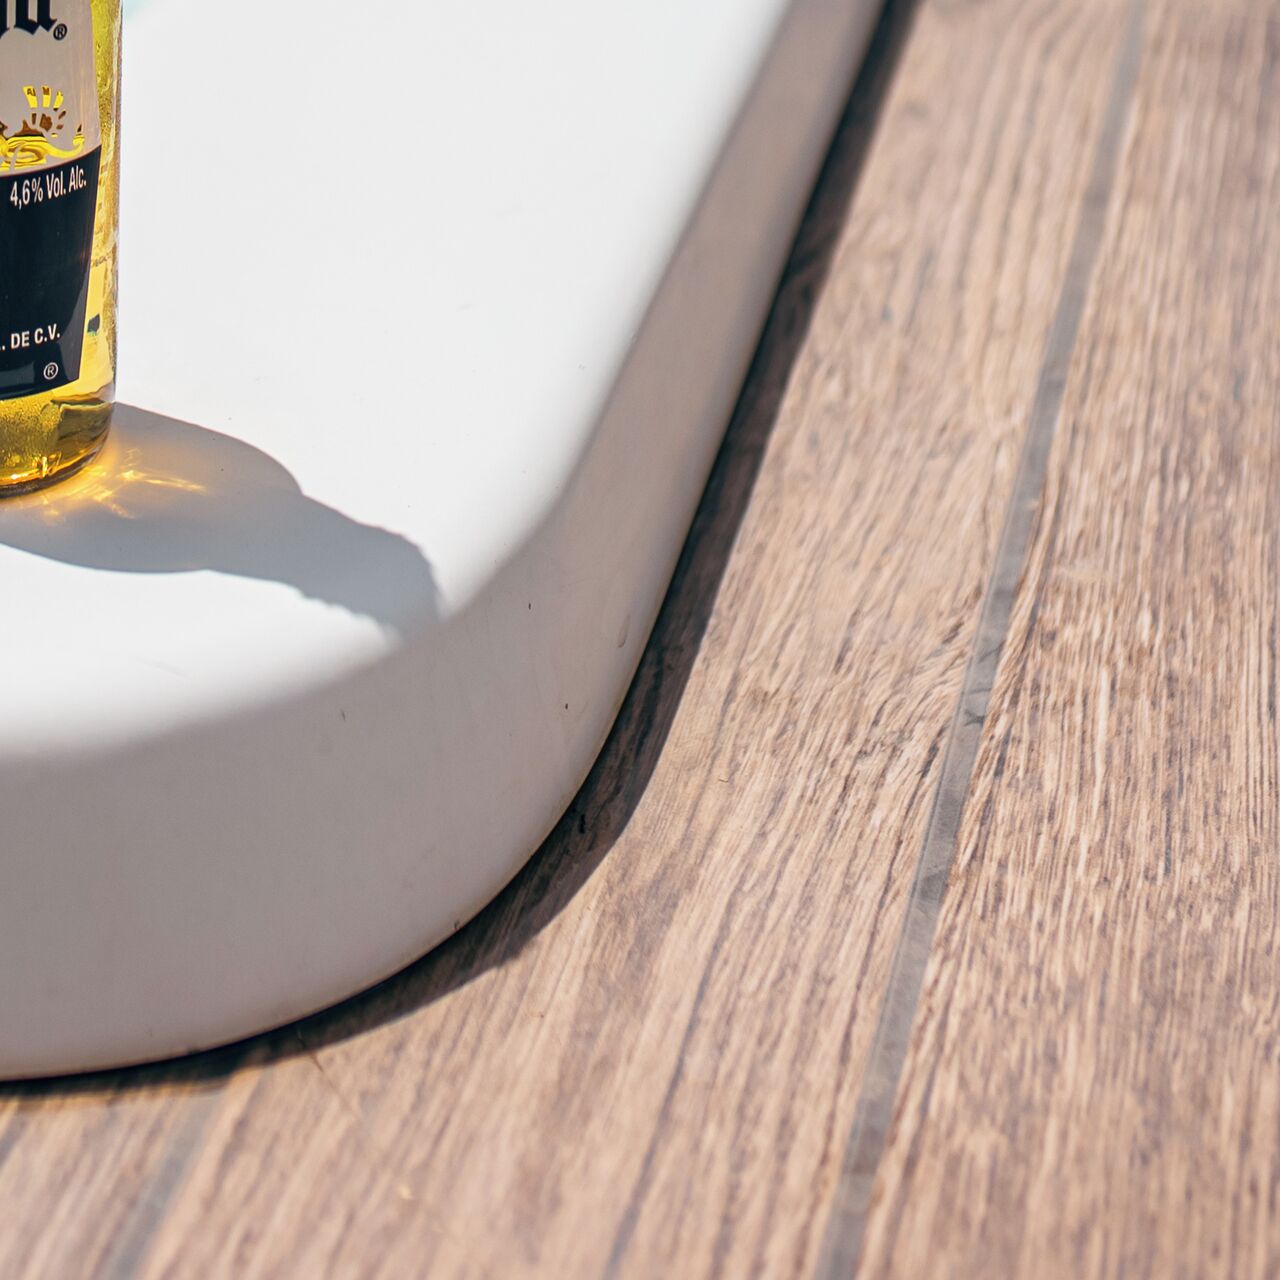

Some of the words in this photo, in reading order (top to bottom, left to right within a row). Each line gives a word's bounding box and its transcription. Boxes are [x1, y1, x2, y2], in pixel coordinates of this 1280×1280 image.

[10, 176, 43, 210] 4,6%
[46, 172, 66, 199] Vol.
[69, 165, 87, 193] Alc.
[11, 331, 30, 349] DE
[34, 323, 61, 344] C.V.
